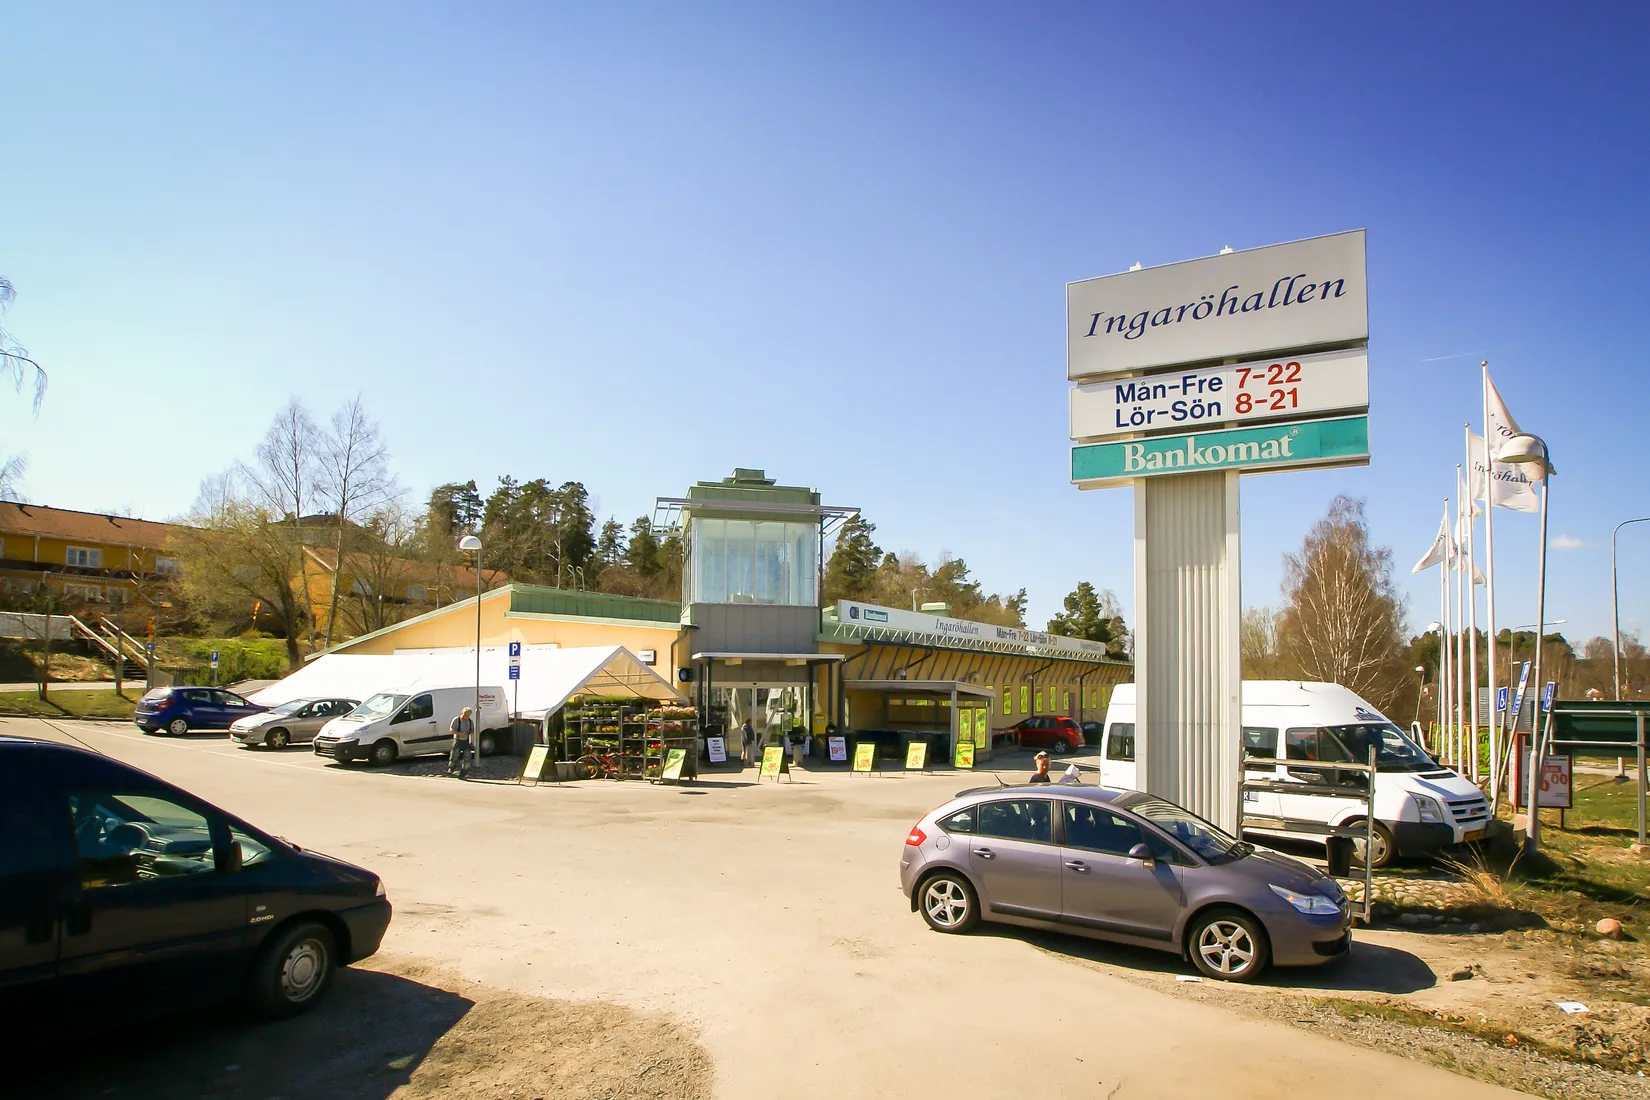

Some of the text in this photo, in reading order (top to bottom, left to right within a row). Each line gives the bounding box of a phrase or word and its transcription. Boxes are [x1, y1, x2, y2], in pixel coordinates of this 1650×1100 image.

[1083, 274, 1347, 340] Ingaröhallen
[1115, 361, 1302, 405] Mån-Fre 7-22
[1115, 387, 1298, 428] Lör-Sön 8-21
[1122, 433, 1294, 472] Bankomat
[935, 618, 979, 636] Ingaröhallen
[511, 643, 519, 656] P
